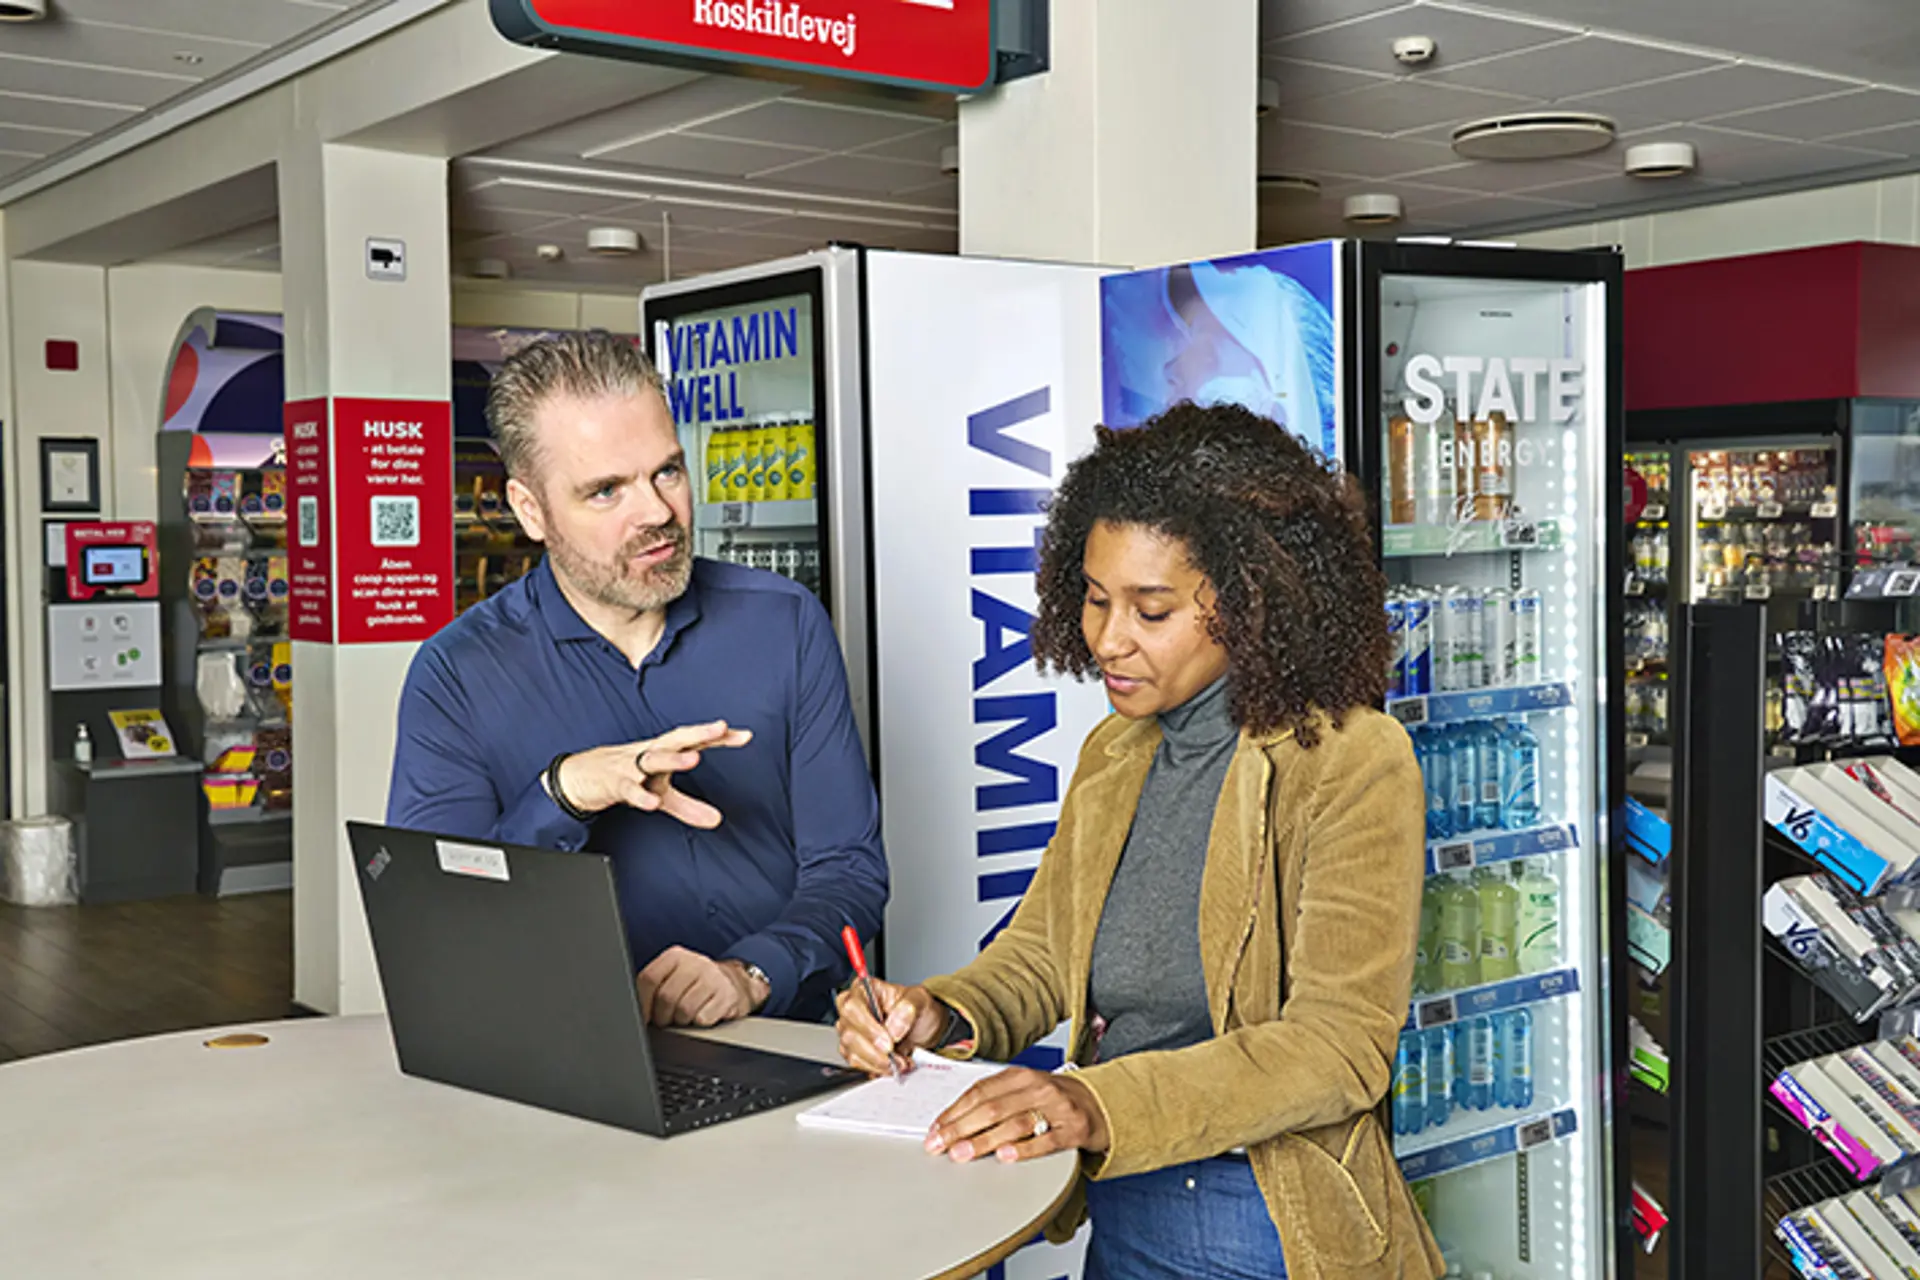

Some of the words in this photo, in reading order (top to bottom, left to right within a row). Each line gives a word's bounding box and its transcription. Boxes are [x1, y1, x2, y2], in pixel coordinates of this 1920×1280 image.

[693, 0, 857, 56] Roskildevej
[665, 307, 797, 373] VITAMIN
[666, 371, 745, 424] WELL
[1404, 354, 1583, 424] STATE
[363, 420, 424, 439] HUSK
[1439, 437, 1549, 468] ENERGY
[1784, 807, 1816, 841] V6
[1786, 921, 1819, 954] V6
